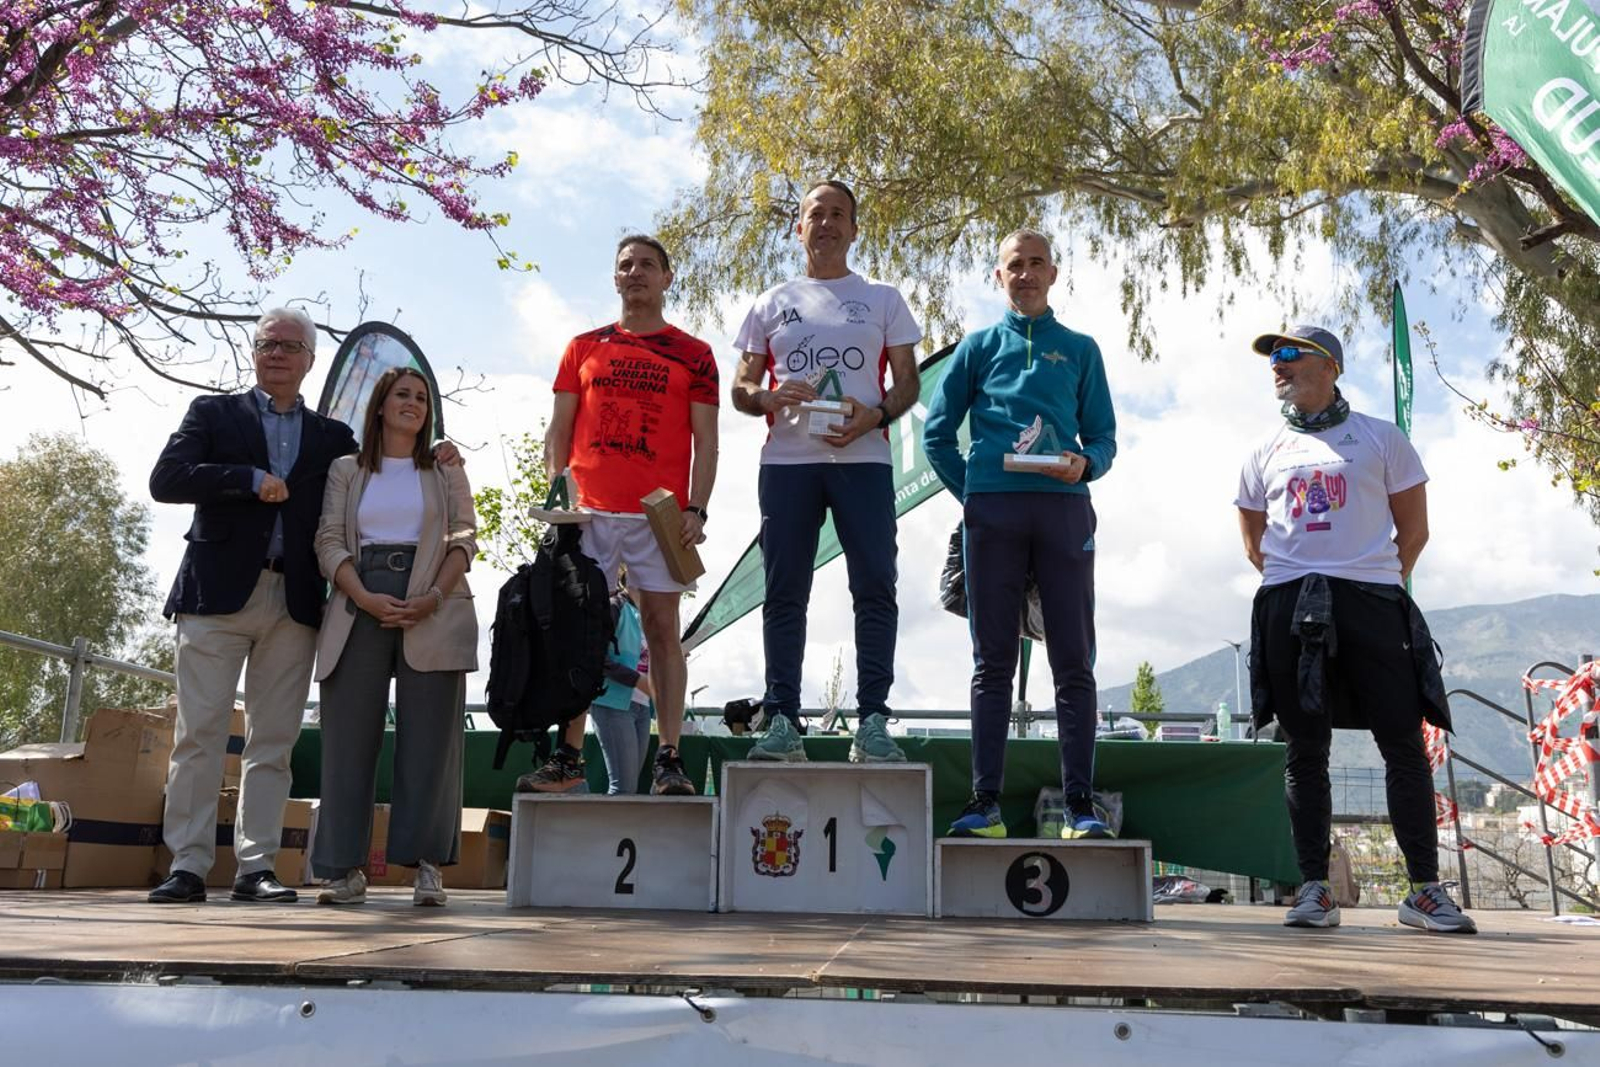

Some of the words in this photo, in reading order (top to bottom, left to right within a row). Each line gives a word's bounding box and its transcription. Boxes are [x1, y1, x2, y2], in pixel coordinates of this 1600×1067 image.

[592, 376, 667, 394] NOCTURNA
[612, 369, 669, 384] URBANA
[627, 360, 670, 374] LEGUA
[823, 817, 837, 872] 1
[614, 838, 637, 894] 2
[1022, 856, 1053, 912] 3
